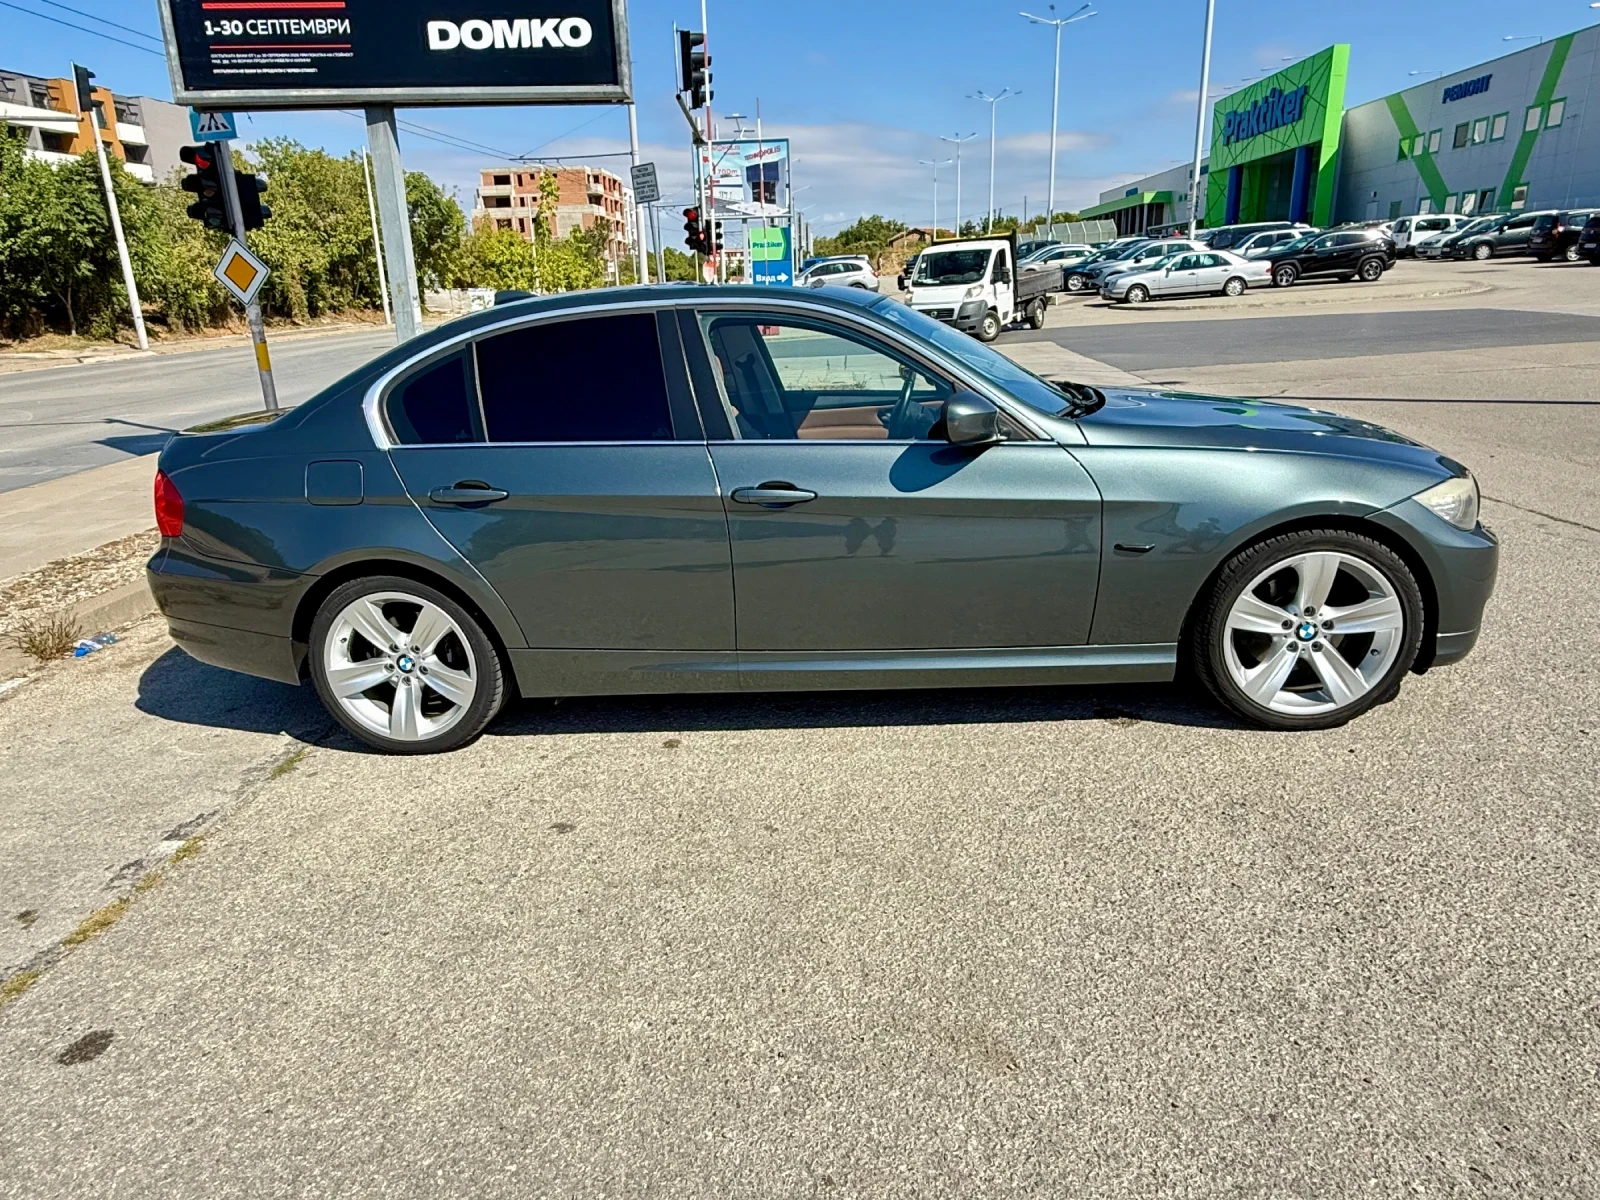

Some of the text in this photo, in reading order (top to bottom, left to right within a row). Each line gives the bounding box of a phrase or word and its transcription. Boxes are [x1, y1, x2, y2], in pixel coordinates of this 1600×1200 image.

[204, 18, 351, 36] 1-30 СЕПТЕМВРИ
[427, 17, 593, 50] DOMKO
[1442, 74, 1493, 104] РЕМОНТ
[1223, 85, 1308, 147] Praktiker
[755, 274, 776, 283] Вход
